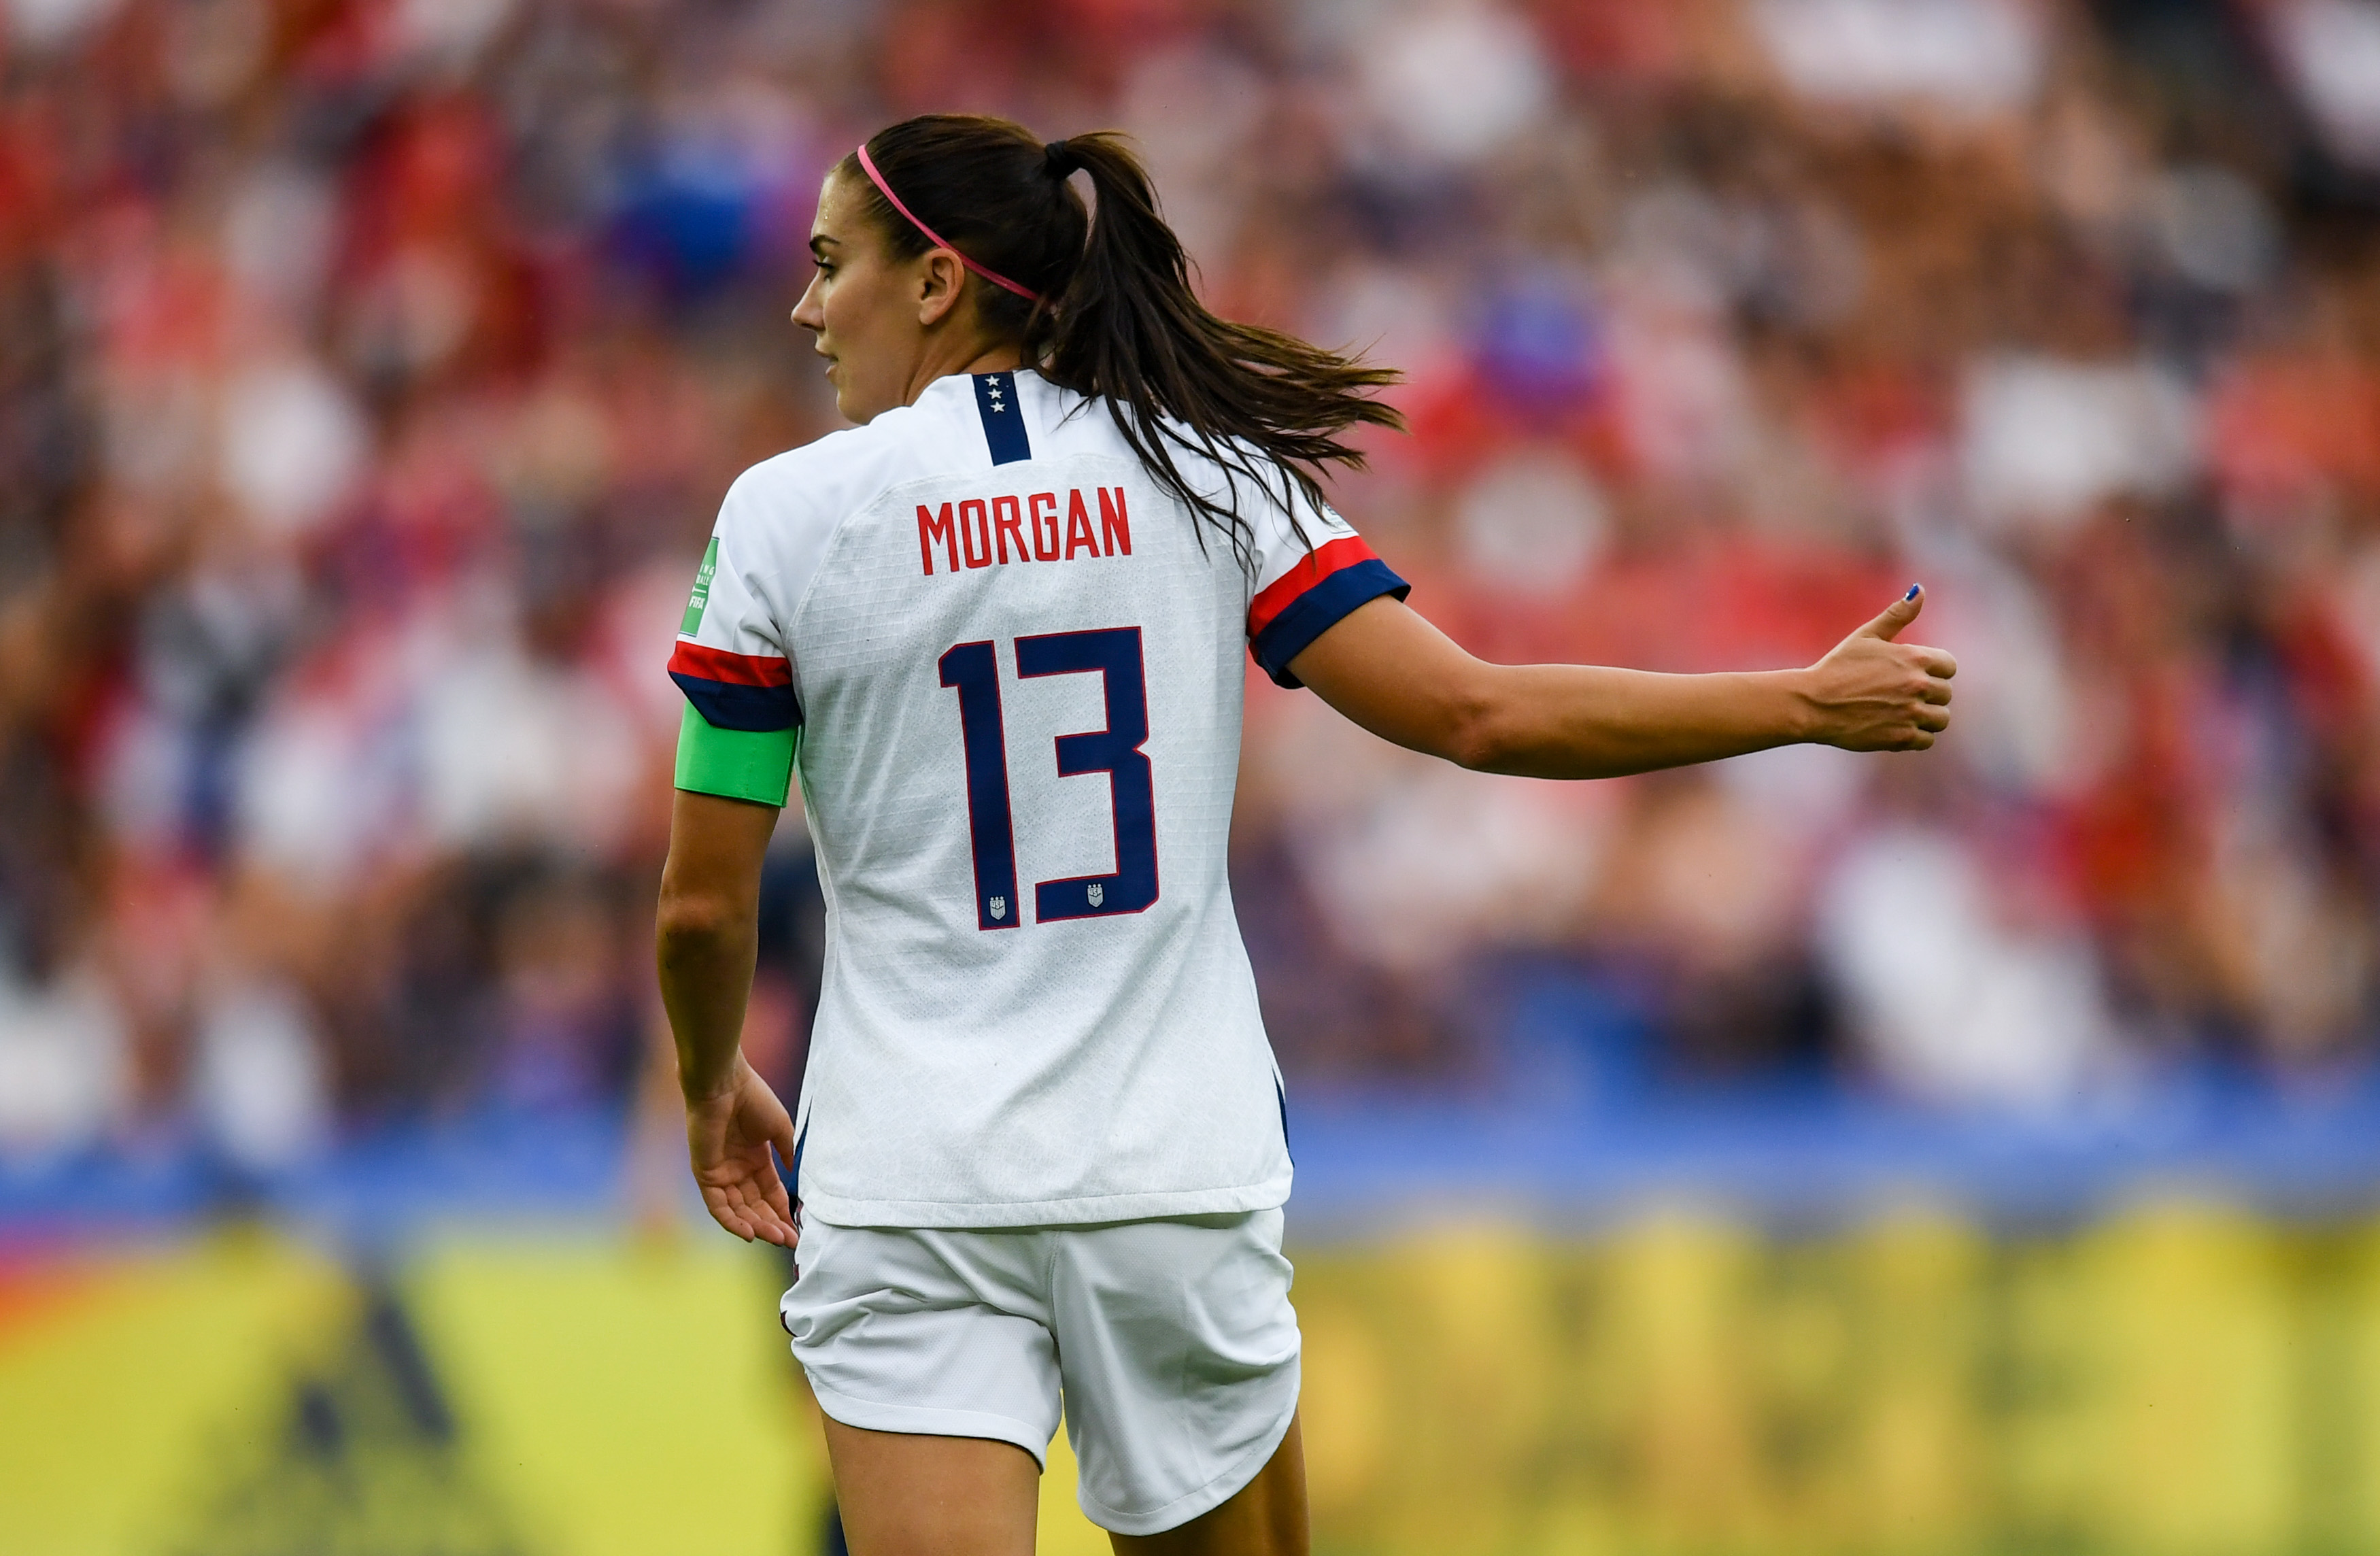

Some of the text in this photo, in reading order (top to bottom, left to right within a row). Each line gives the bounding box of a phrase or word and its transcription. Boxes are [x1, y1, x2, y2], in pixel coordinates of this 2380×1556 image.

[916, 487, 1132, 576] MORGAN
[689, 596, 705, 609] FIFA
[938, 626, 1159, 931] 13
